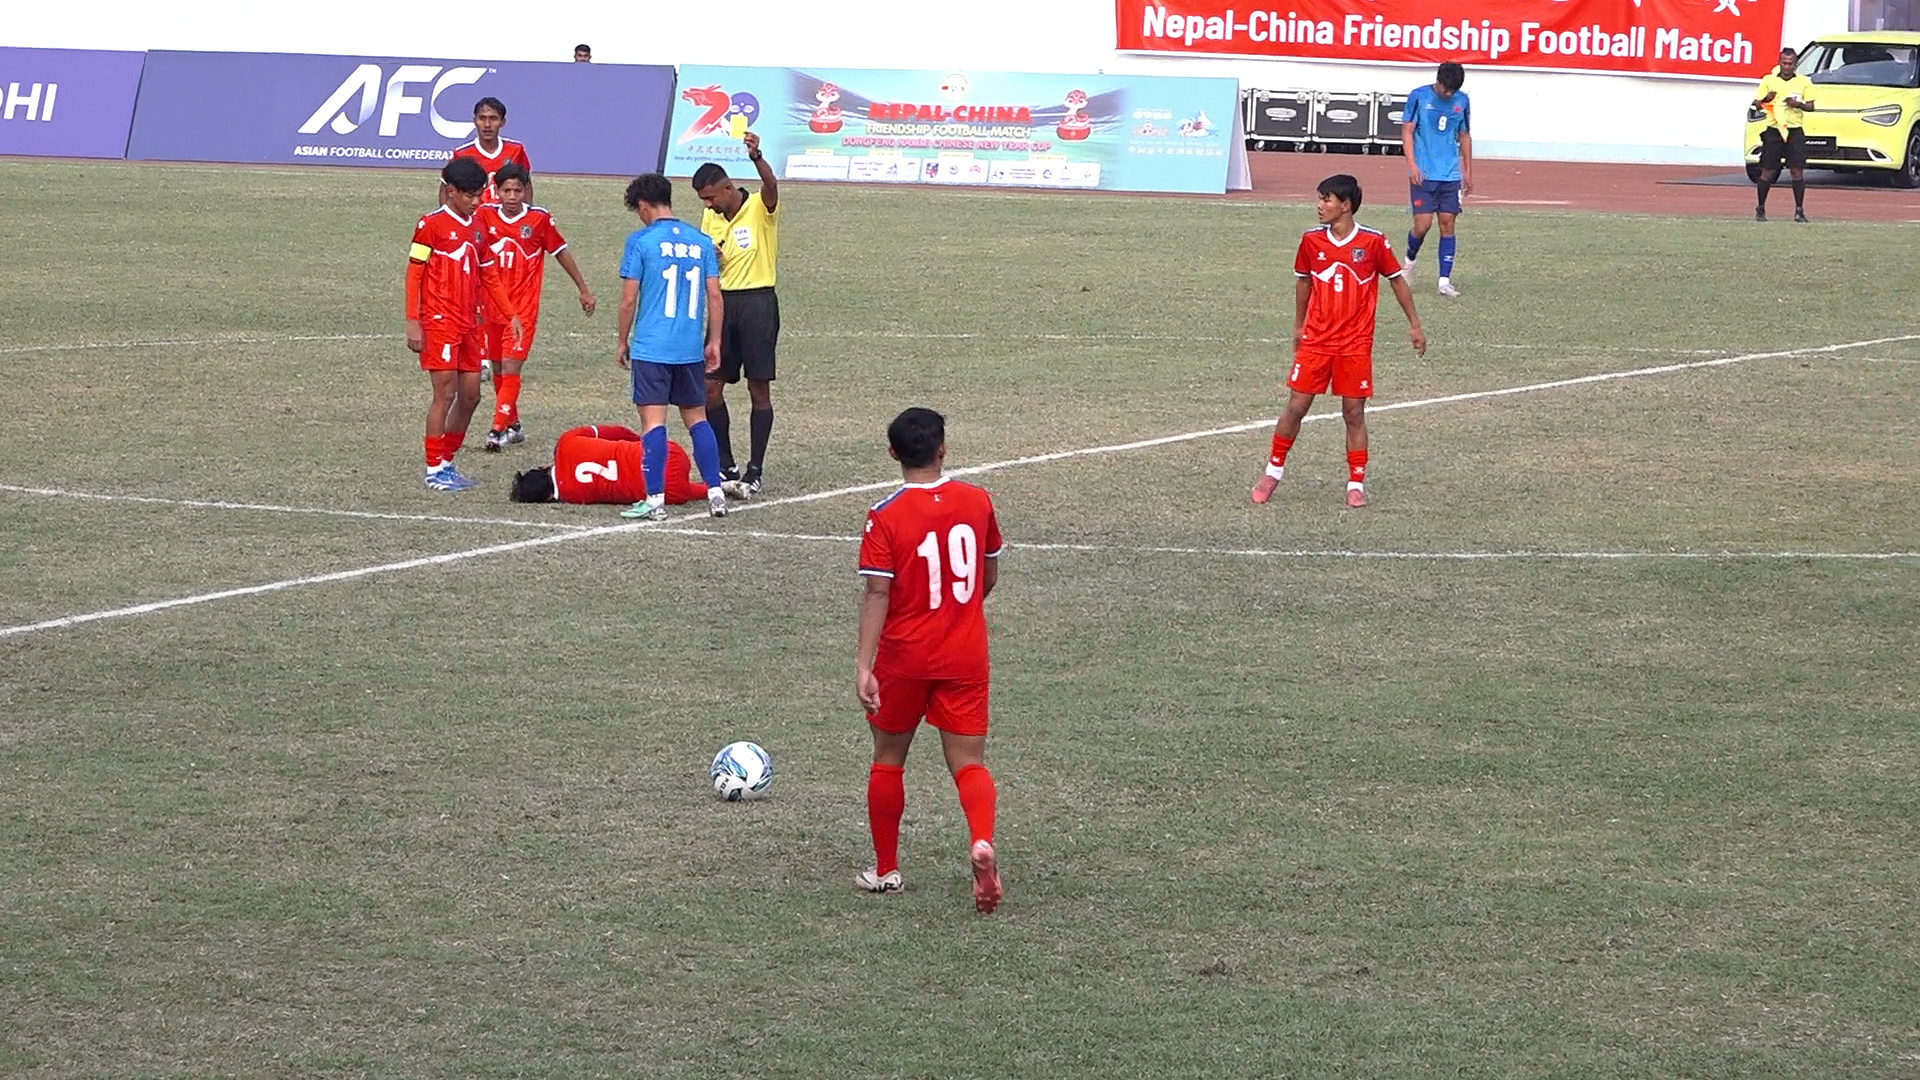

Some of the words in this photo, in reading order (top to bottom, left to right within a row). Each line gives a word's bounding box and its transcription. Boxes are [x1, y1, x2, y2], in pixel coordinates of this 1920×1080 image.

[1143, 5, 1334, 46] Nepal-China
[1343, 14, 1510, 60] Friendship
[1520, 21, 1646, 58] Football
[1654, 27, 1753, 64] Match
[0, 82, 58, 122] HI
[297, 64, 488, 139] AFC
[869, 103, 1032, 124] NEPAL-CHINA
[1438, 116, 1448, 131] 9
[866, 123, 931, 135] FRIENDSHIP
[933, 124, 989, 137] FOOTBALL
[990, 126, 1032, 138] MATCH
[293, 145, 328, 157] ASIAN
[330, 147, 383, 159] FOOTBALL
[842, 136, 895, 147] DONGFENG
[933, 139, 974, 150] CHINESE
[977, 140, 1000, 150] NEW
[1002, 141, 1029, 151] YEAR
[1030, 142, 1052, 152] CUP
[463, 256, 471, 275] 4
[499, 251, 514, 269] 17
[662, 264, 702, 320] 11
[1333, 274, 1344, 293] 5
[441, 343, 451, 363] 4
[575, 460, 618, 484] 2
[916, 523, 978, 610] 19
